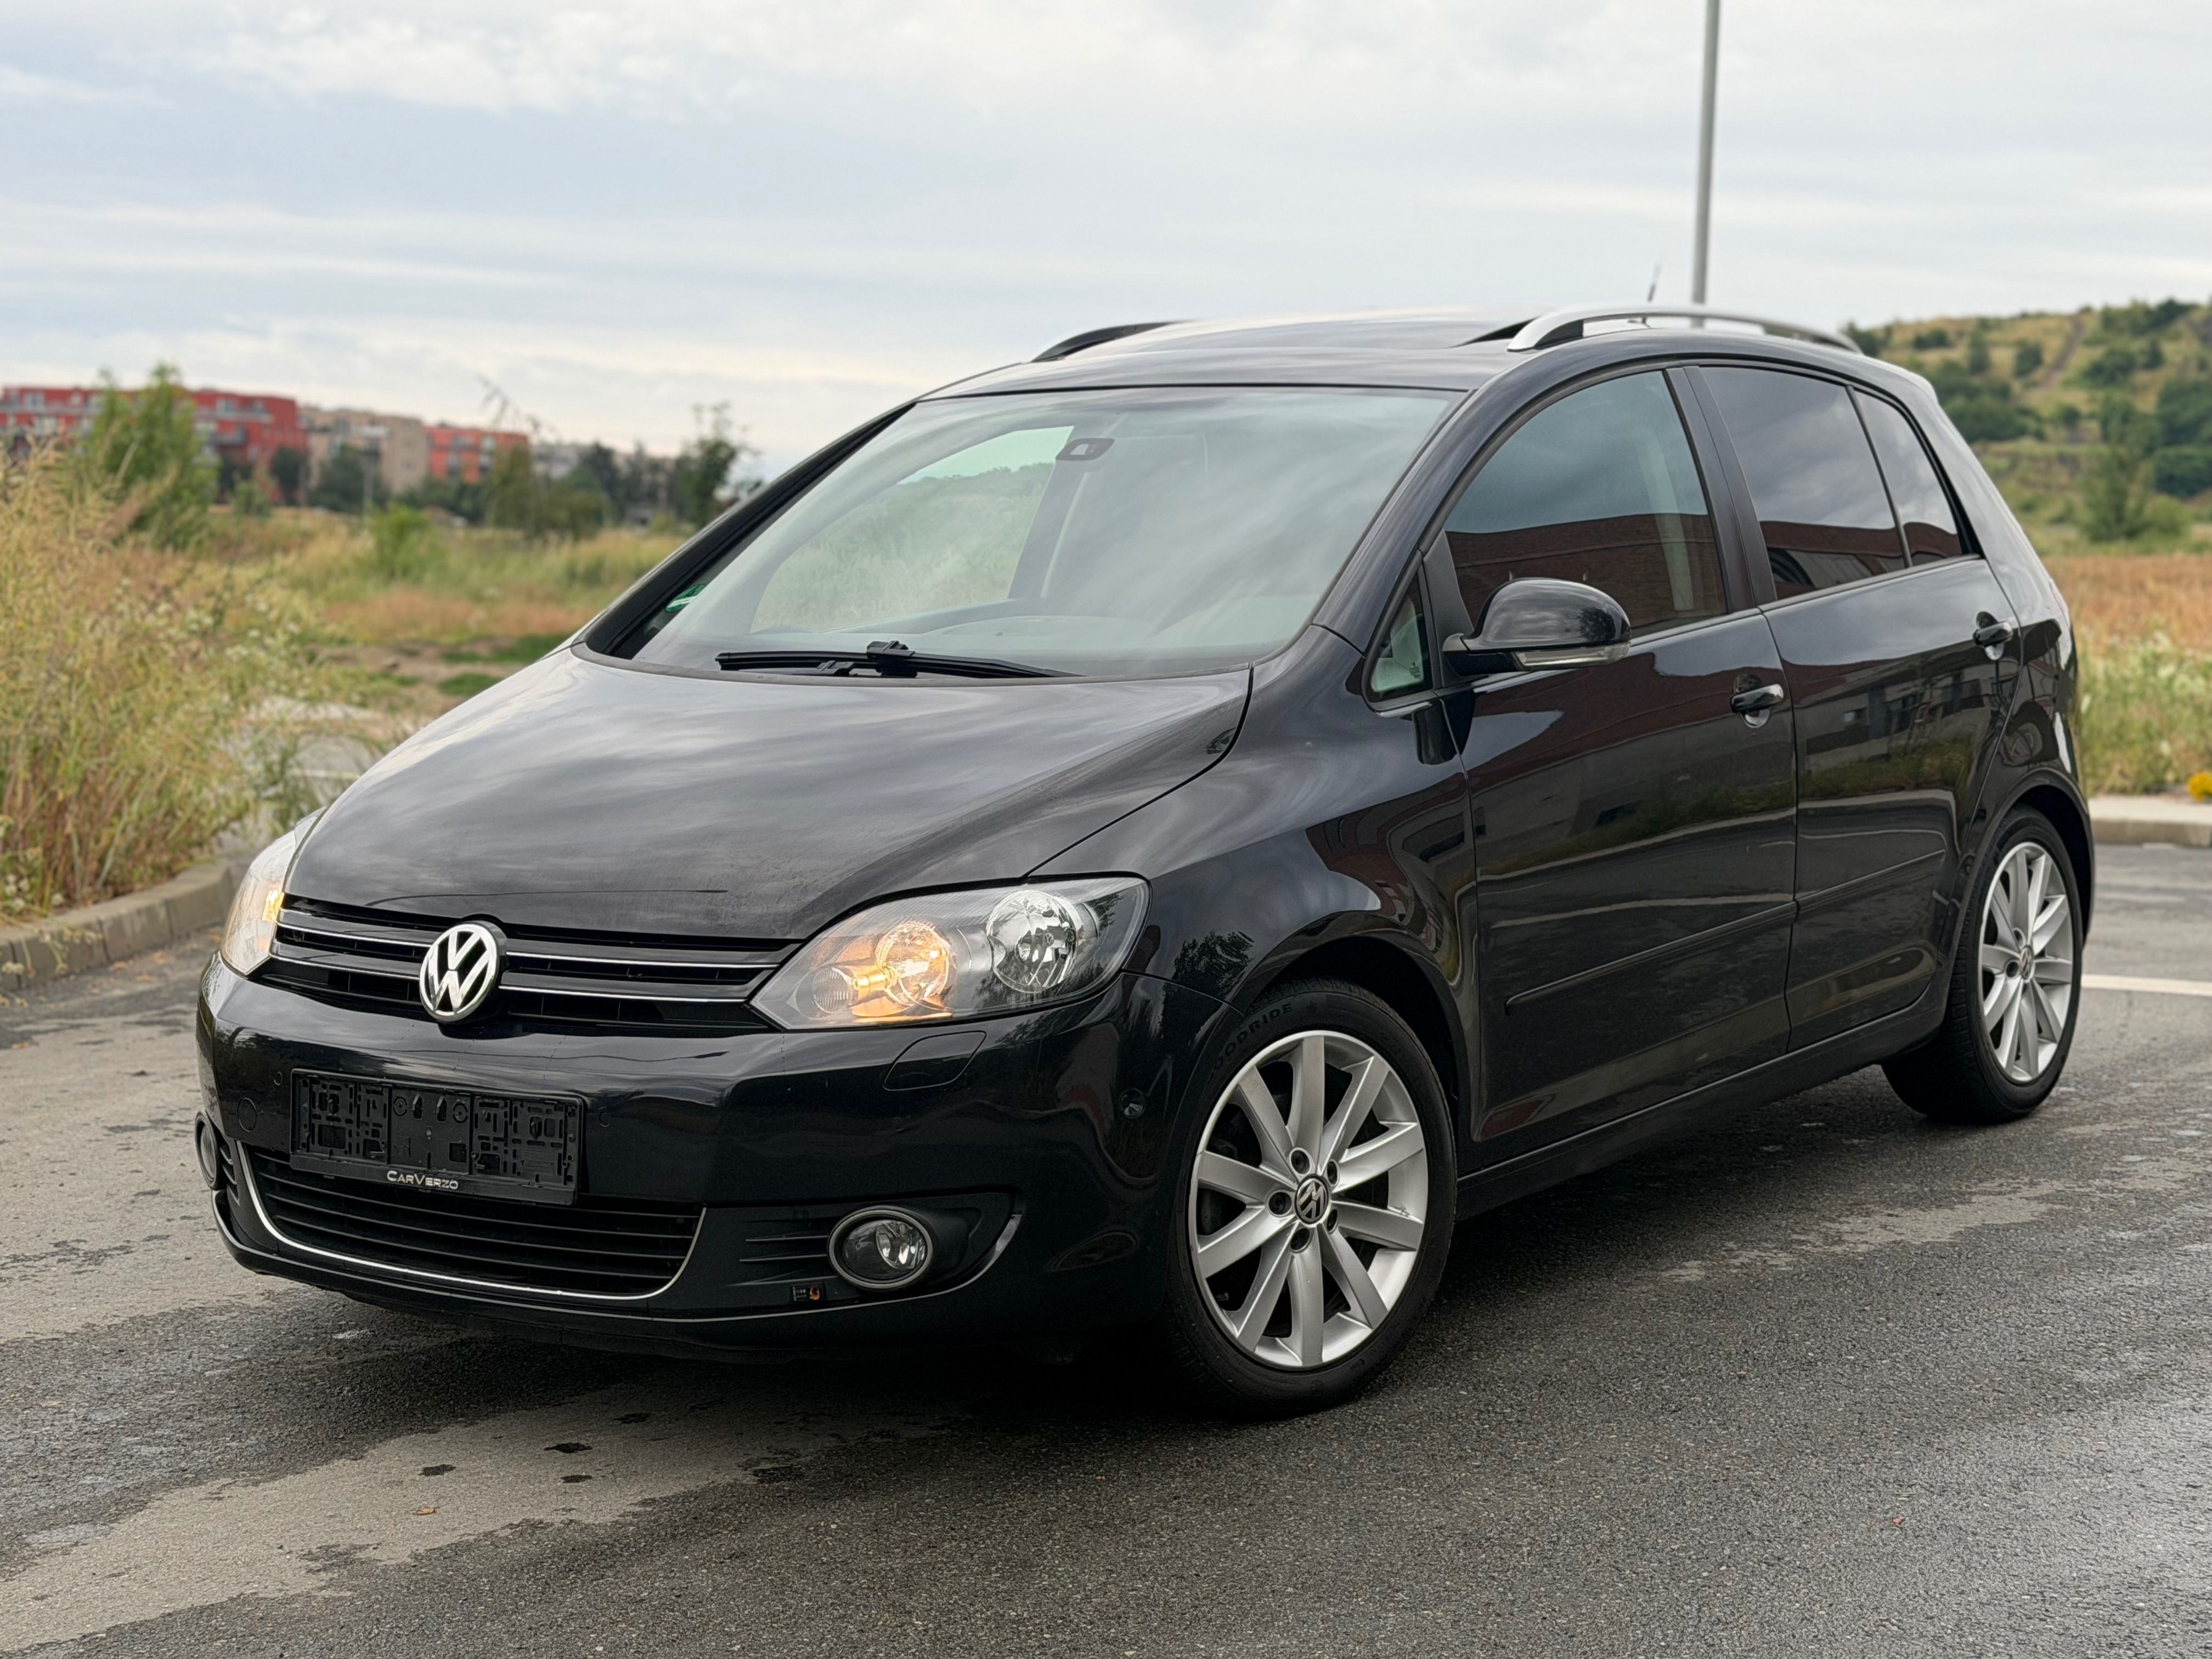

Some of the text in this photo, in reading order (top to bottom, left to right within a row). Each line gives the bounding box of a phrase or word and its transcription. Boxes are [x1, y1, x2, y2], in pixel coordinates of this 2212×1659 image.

[420, 923, 496, 1018] VW
[1213, 1003, 1293, 1071] OODRIDE
[386, 1170, 459, 1189] CARVERZO
